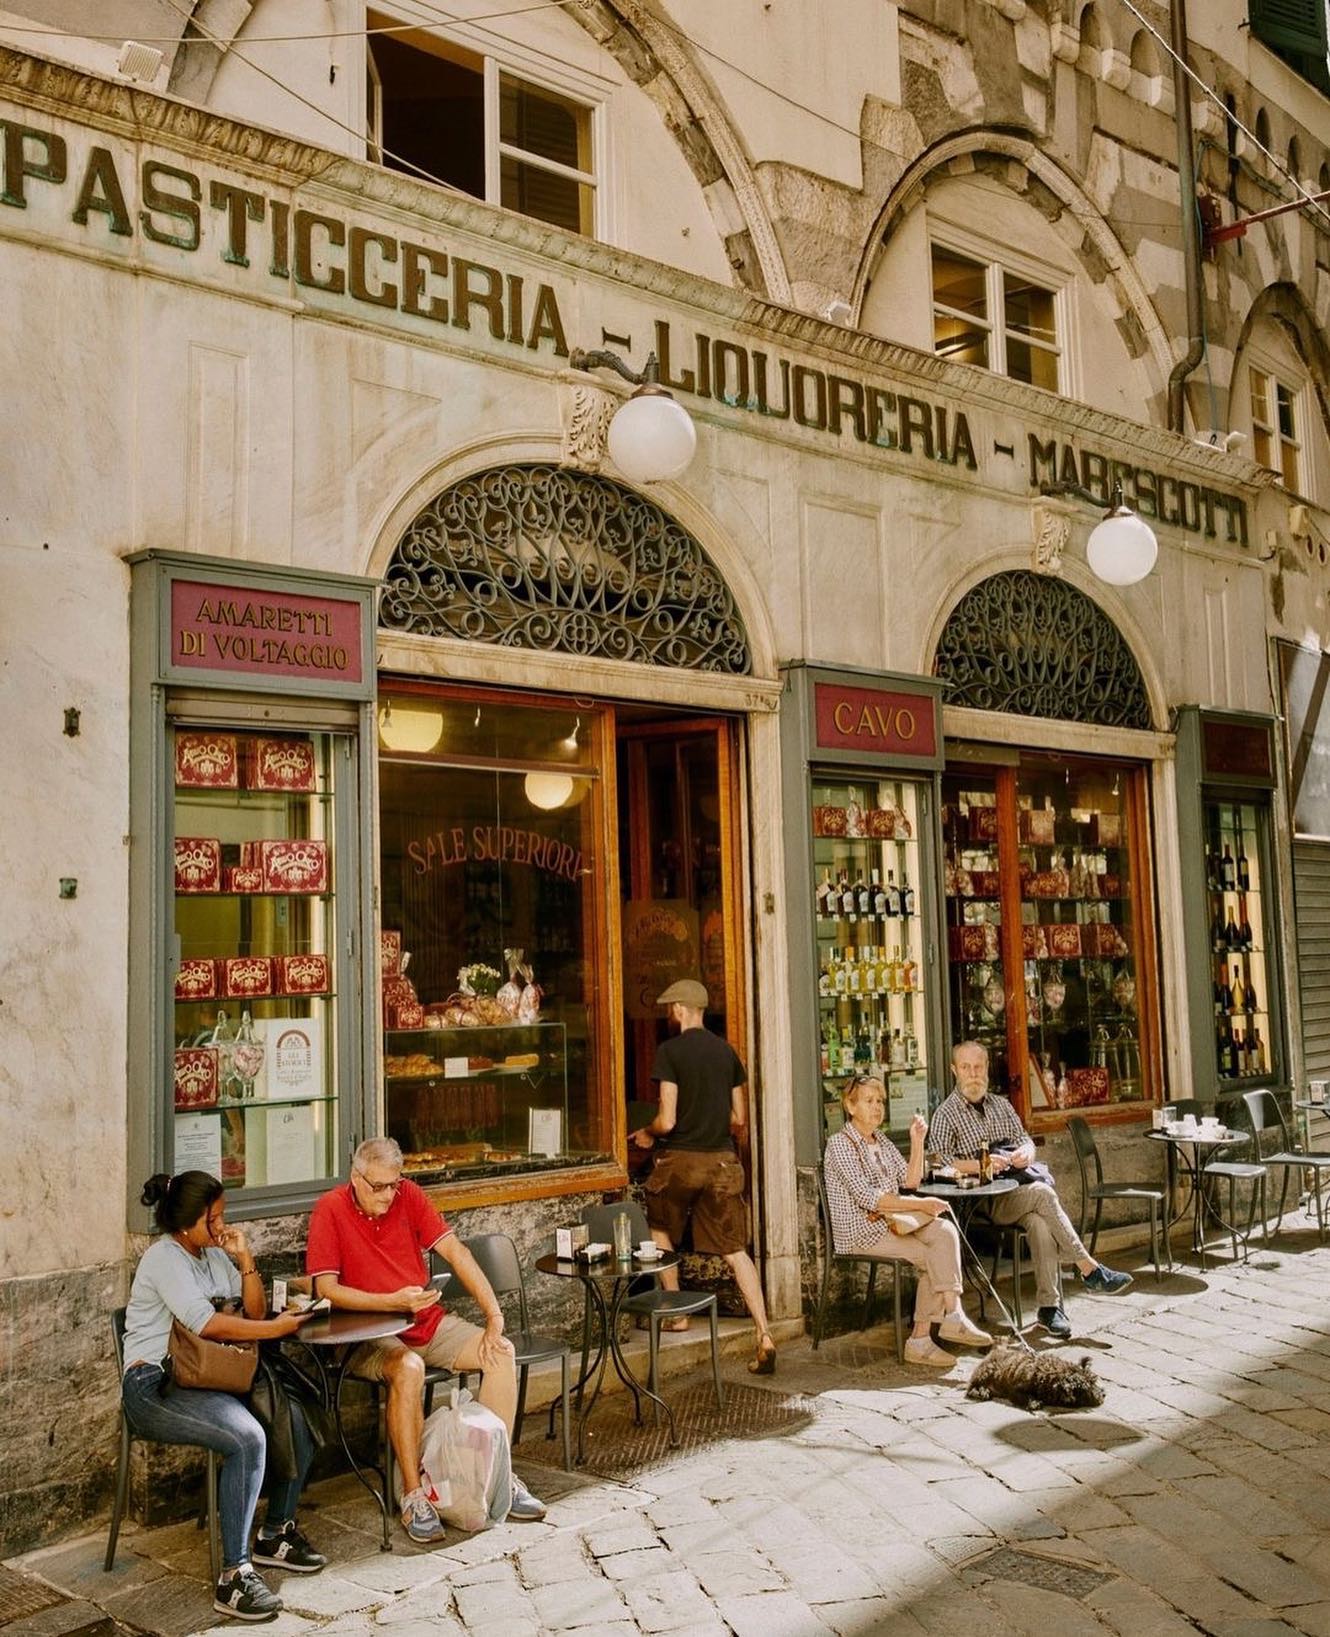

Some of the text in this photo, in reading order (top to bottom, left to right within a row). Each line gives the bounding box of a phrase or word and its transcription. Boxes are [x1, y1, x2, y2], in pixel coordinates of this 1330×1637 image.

[0, 119, 571, 357] PASTICCERIA
[654, 320, 978, 472] LIQUORERIA
[195, 599, 334, 637] AMARETTI
[179, 629, 350, 671] DI VOLTAGGIO
[833, 701, 916, 741] CAVO
[407, 827, 468, 875] SALE
